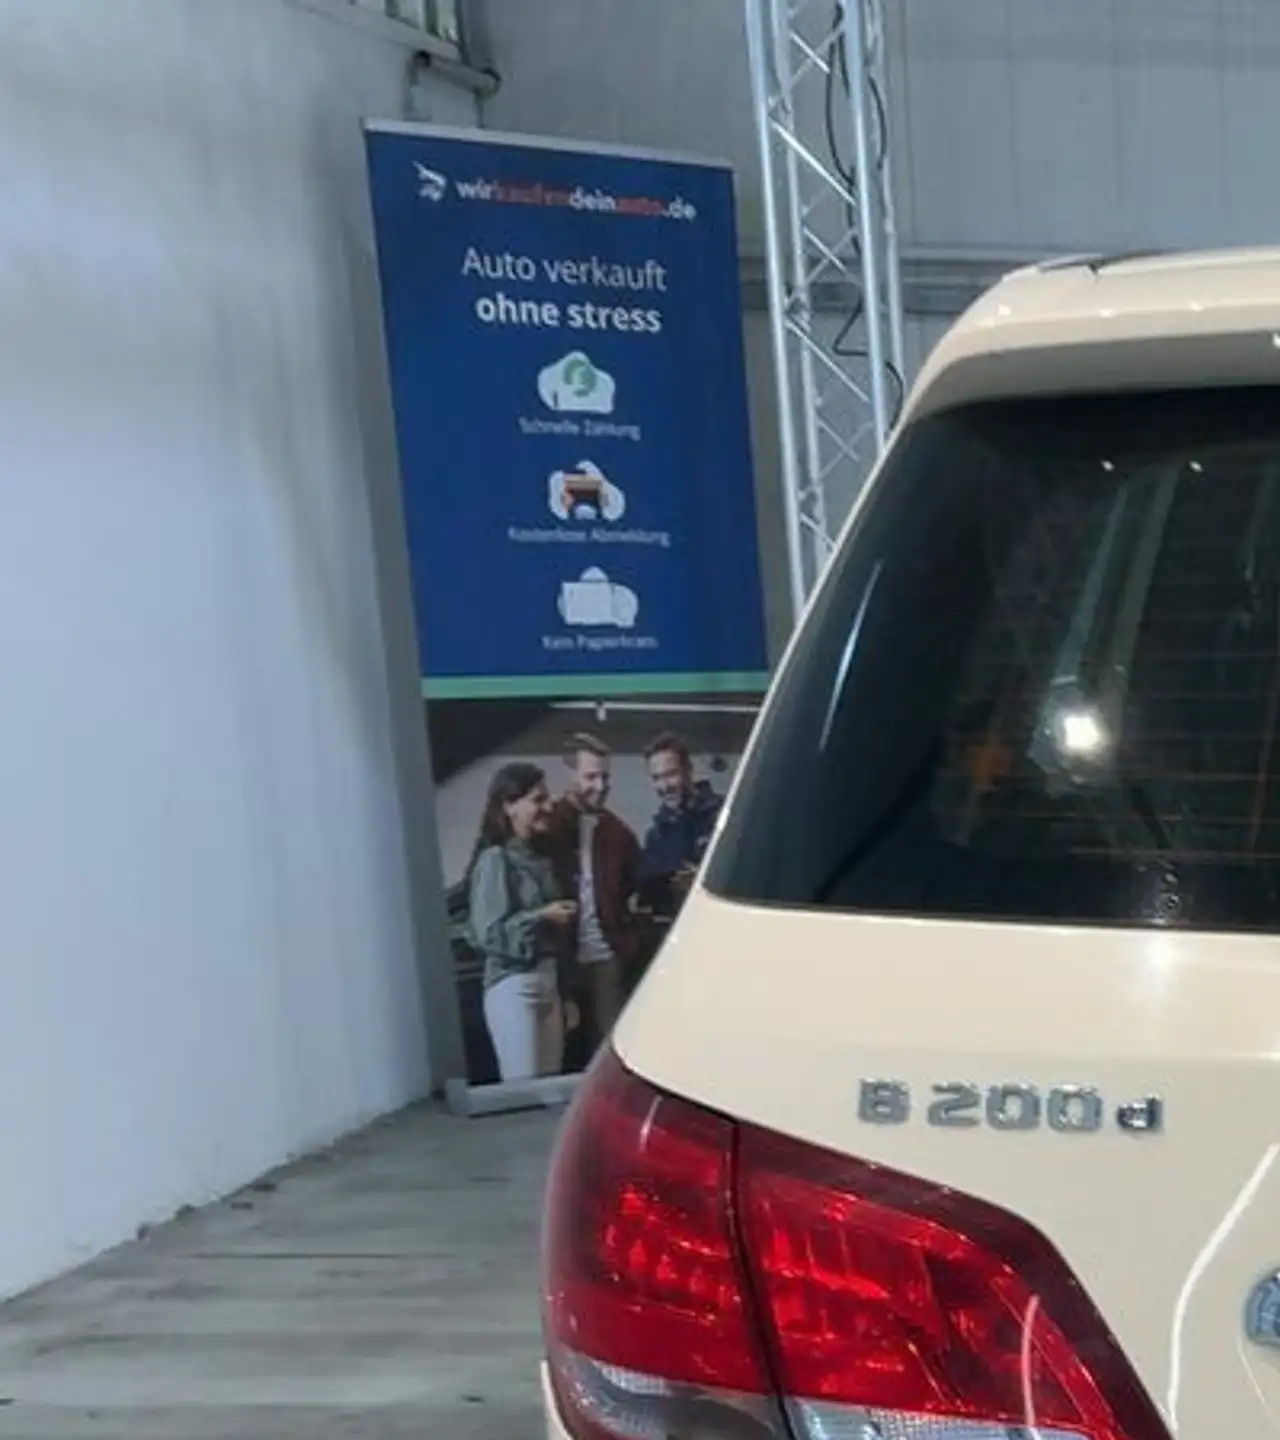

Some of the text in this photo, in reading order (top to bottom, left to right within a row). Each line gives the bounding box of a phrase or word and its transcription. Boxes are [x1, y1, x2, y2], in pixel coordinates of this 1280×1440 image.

[461, 246, 668, 293] Auto verkauft
[476, 292, 662, 334] ohne stress
[857, 1077, 1164, 1136] B 200 d
